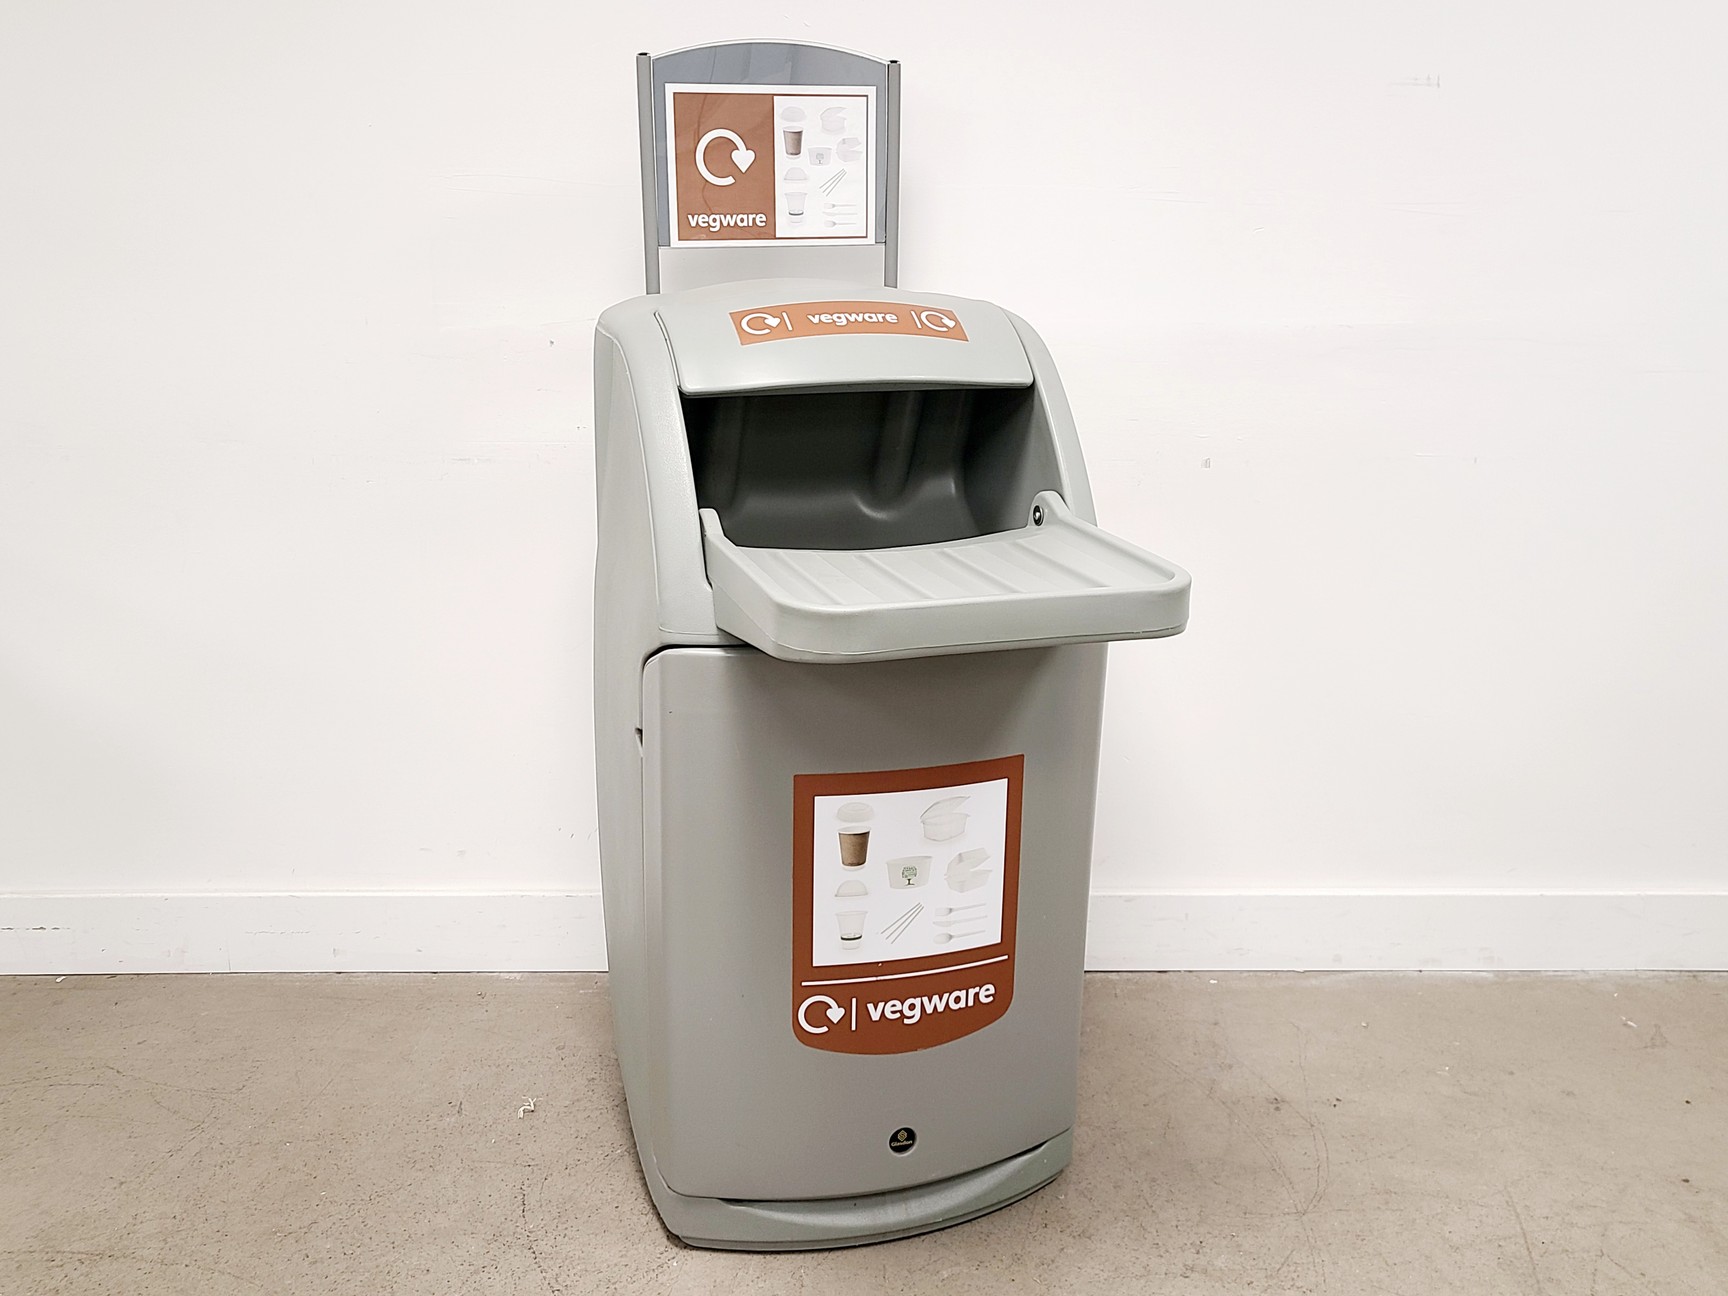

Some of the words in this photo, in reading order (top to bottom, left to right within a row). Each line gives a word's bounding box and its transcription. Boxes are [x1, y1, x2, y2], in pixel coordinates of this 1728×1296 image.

[687, 213, 767, 232] vegware
[806, 311, 899, 326] vegware
[866, 983, 996, 1025] vegware
